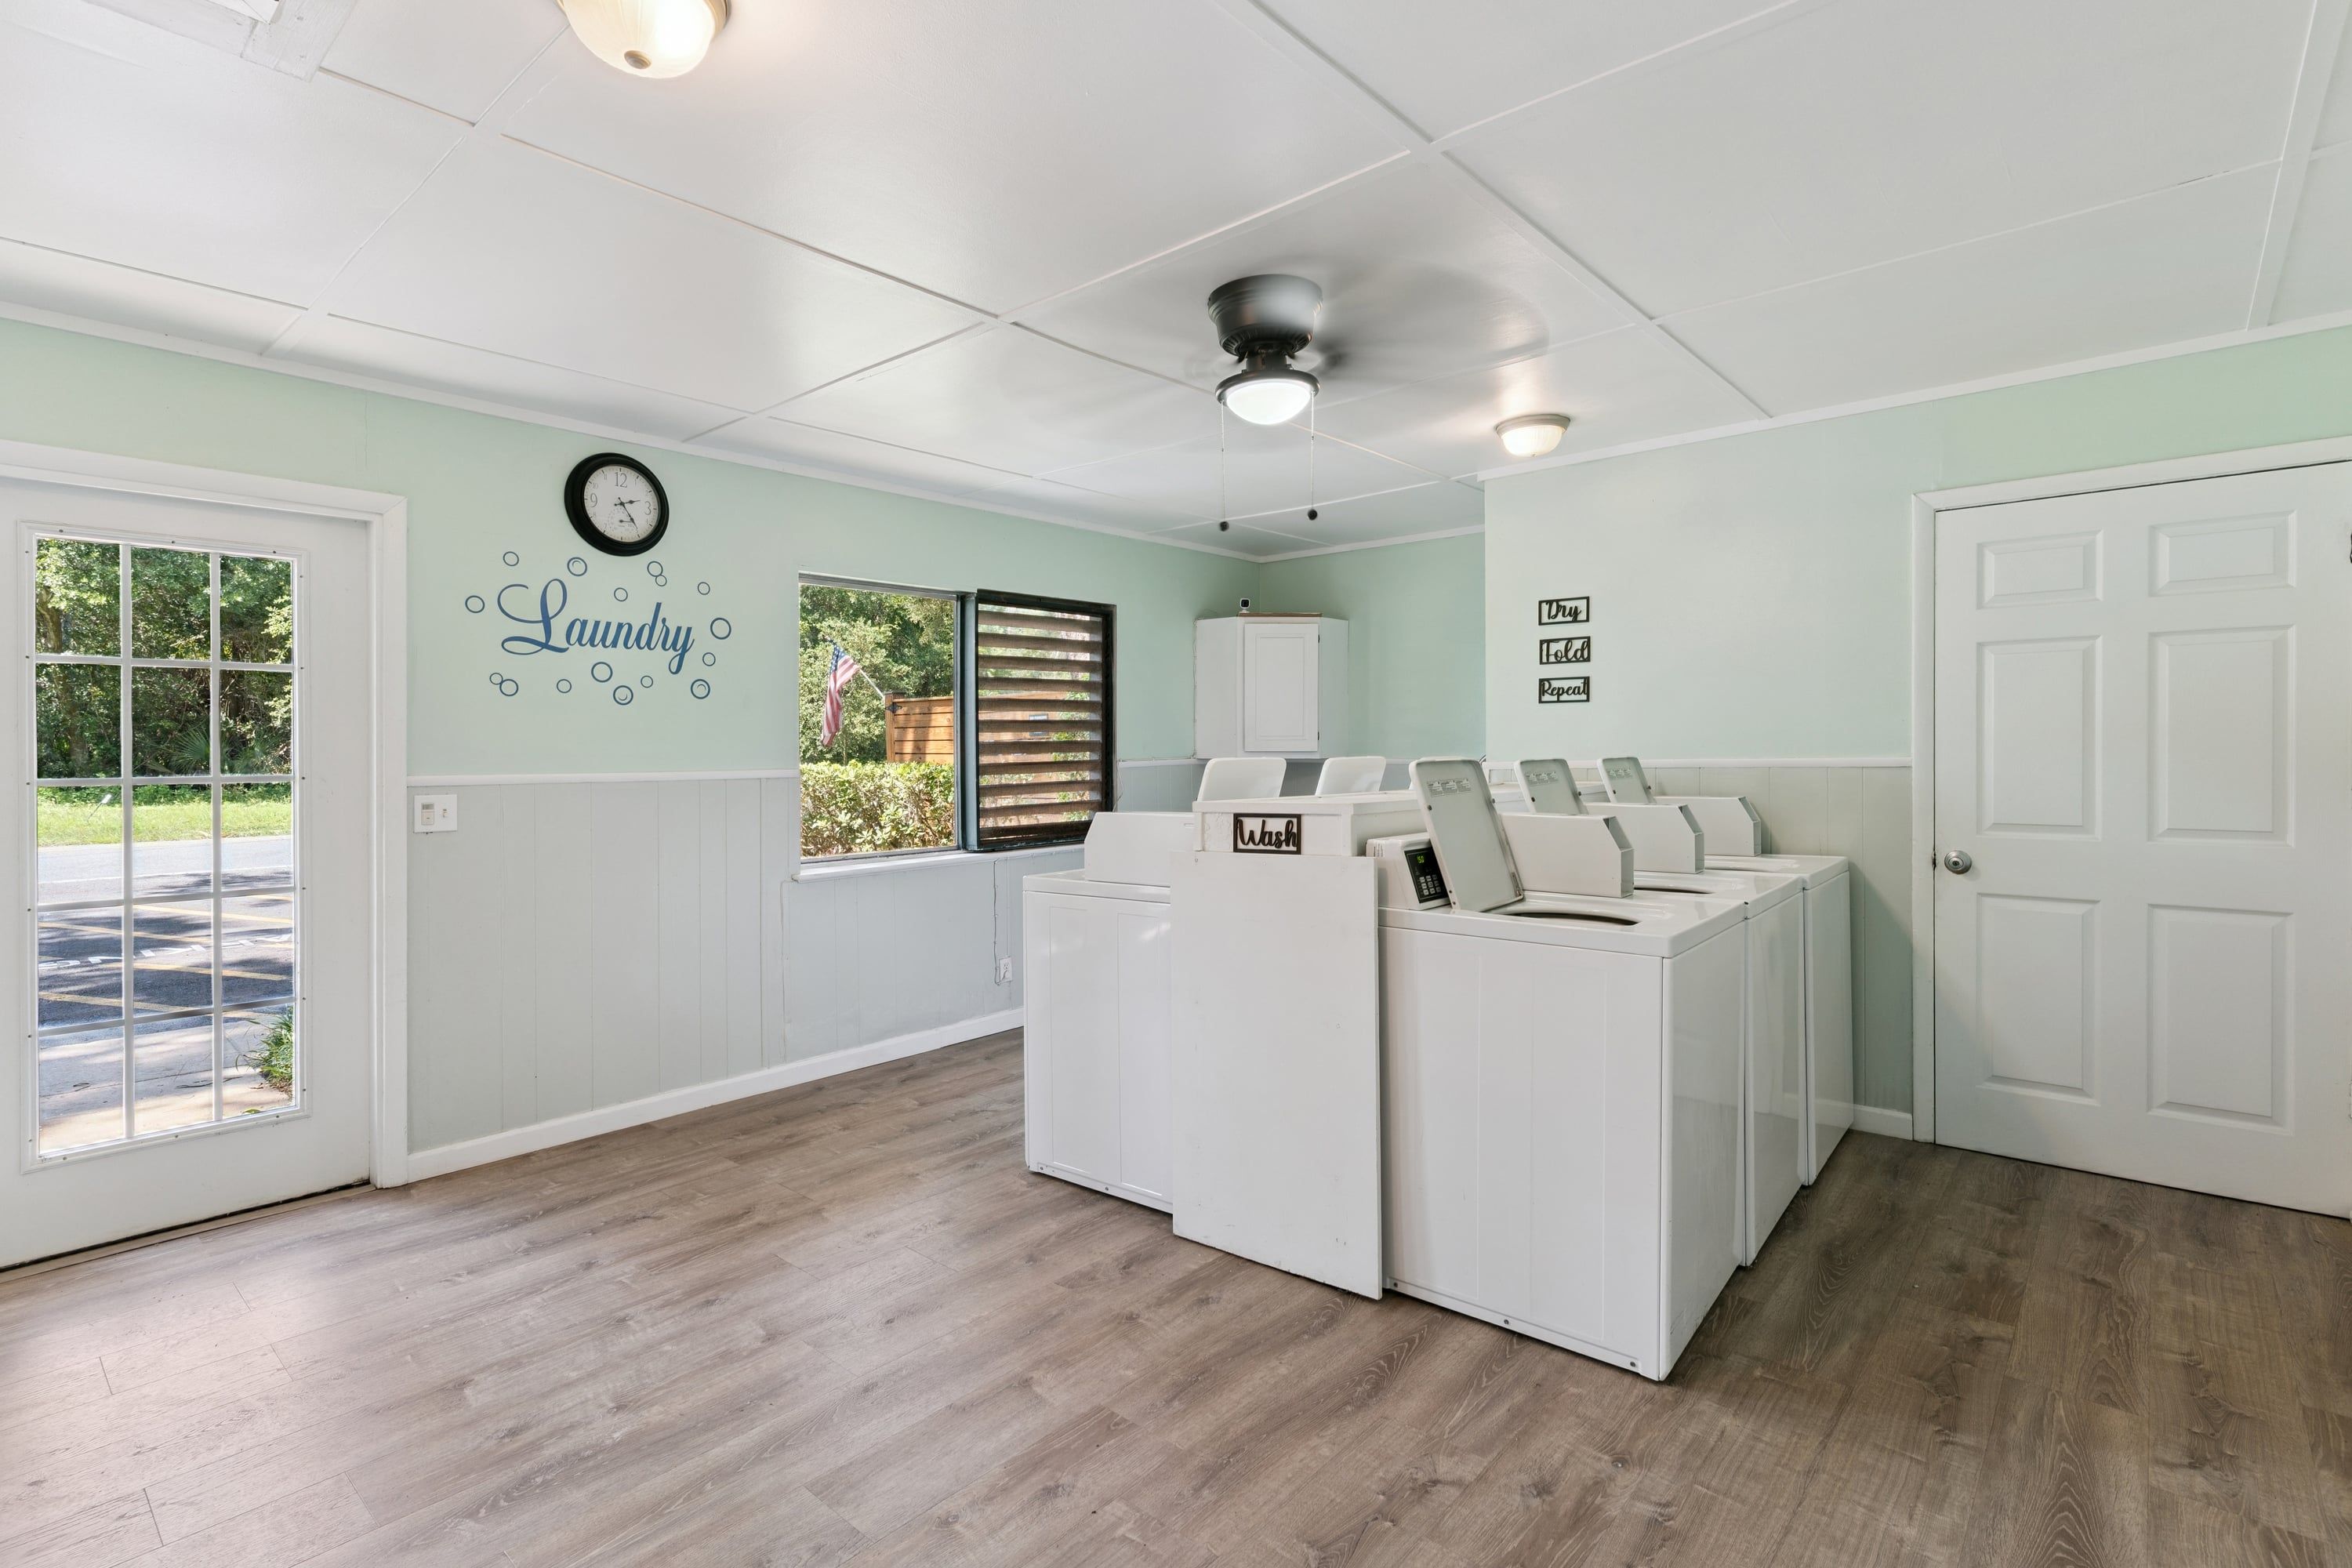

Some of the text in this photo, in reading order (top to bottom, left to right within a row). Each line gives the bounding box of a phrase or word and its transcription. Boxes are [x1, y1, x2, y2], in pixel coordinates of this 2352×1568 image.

[615, 472, 628, 488] 12
[590, 492, 598, 508] 9
[644, 501, 652, 516] 3
[1545, 601, 1581, 622] Dry
[497, 579, 695, 675] Laundry
[1541, 640, 1589, 662] Fold
[1541, 679, 1588, 701] Repeat
[1236, 818, 1298, 848] Wash
